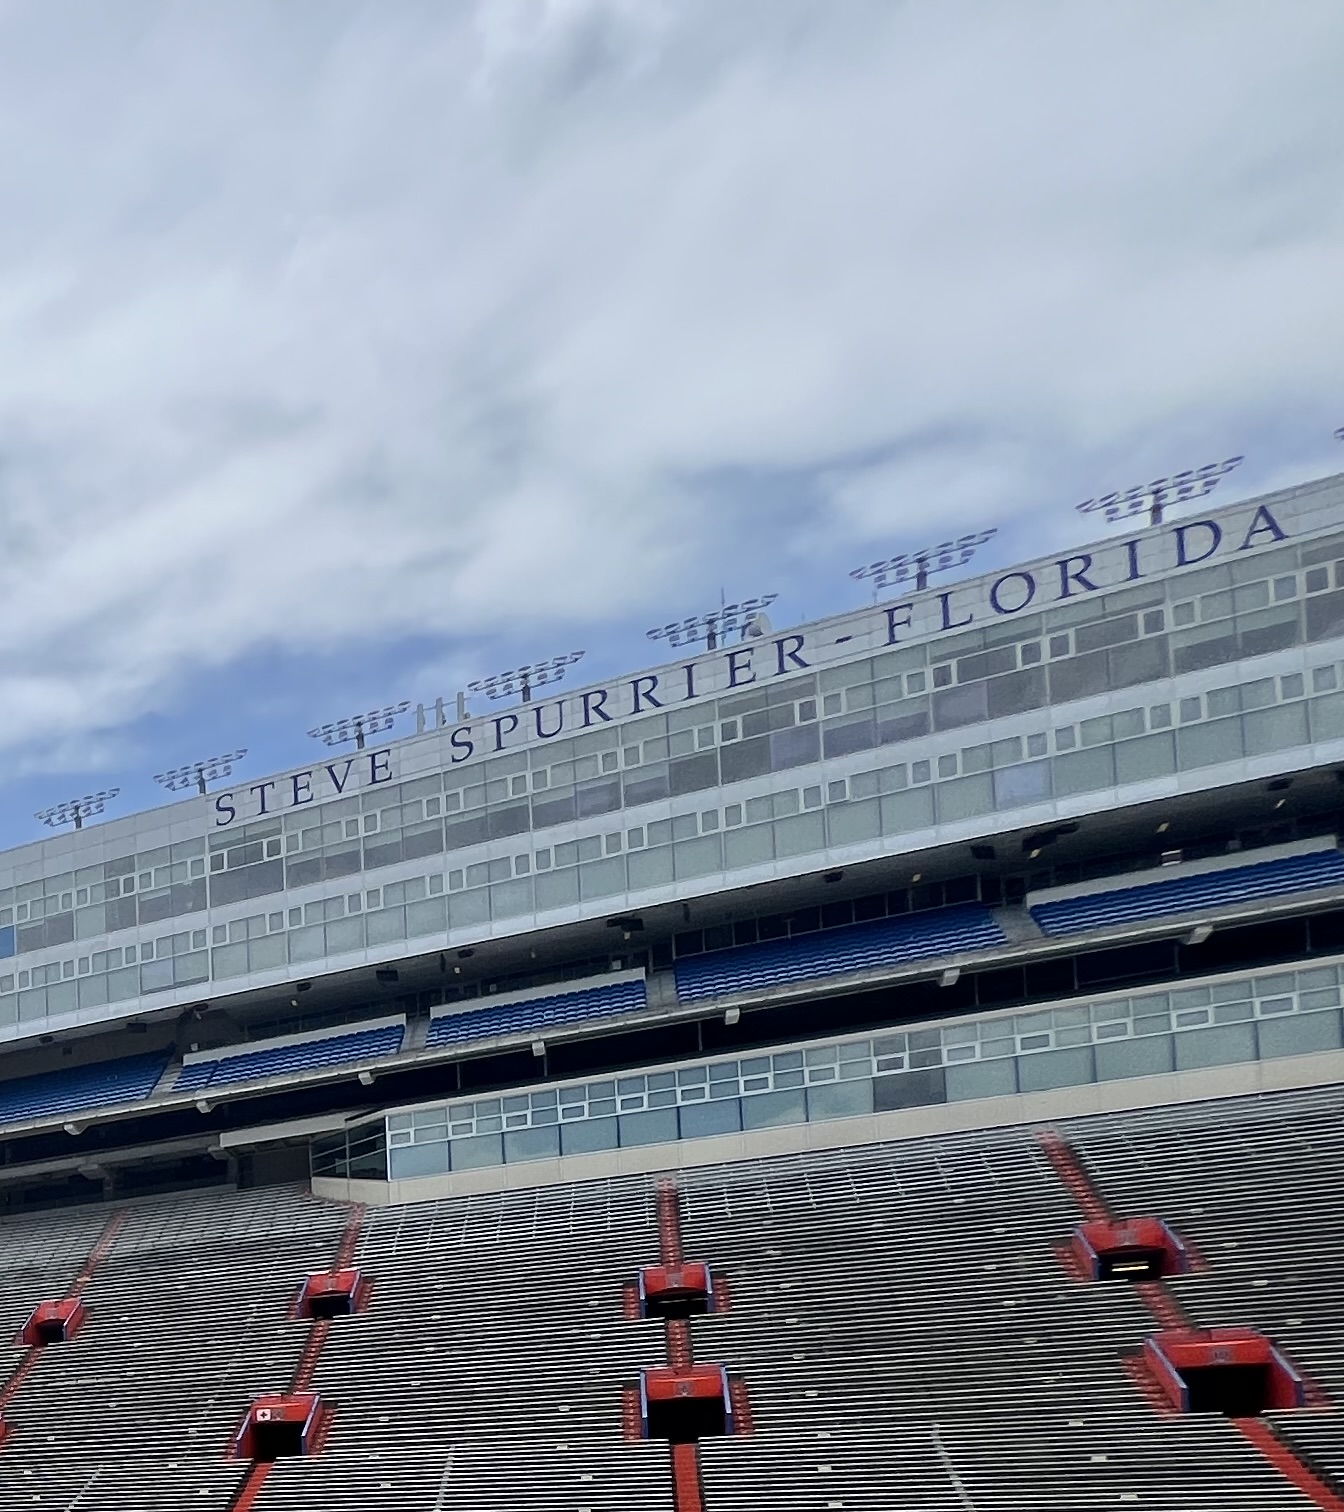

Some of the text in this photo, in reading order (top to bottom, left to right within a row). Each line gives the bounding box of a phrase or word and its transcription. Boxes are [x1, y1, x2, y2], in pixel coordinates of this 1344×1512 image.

[212, 747, 395, 827] STEVE
[451, 633, 811, 764] SPURRIER
[882, 503, 1292, 646] FLORIDA
